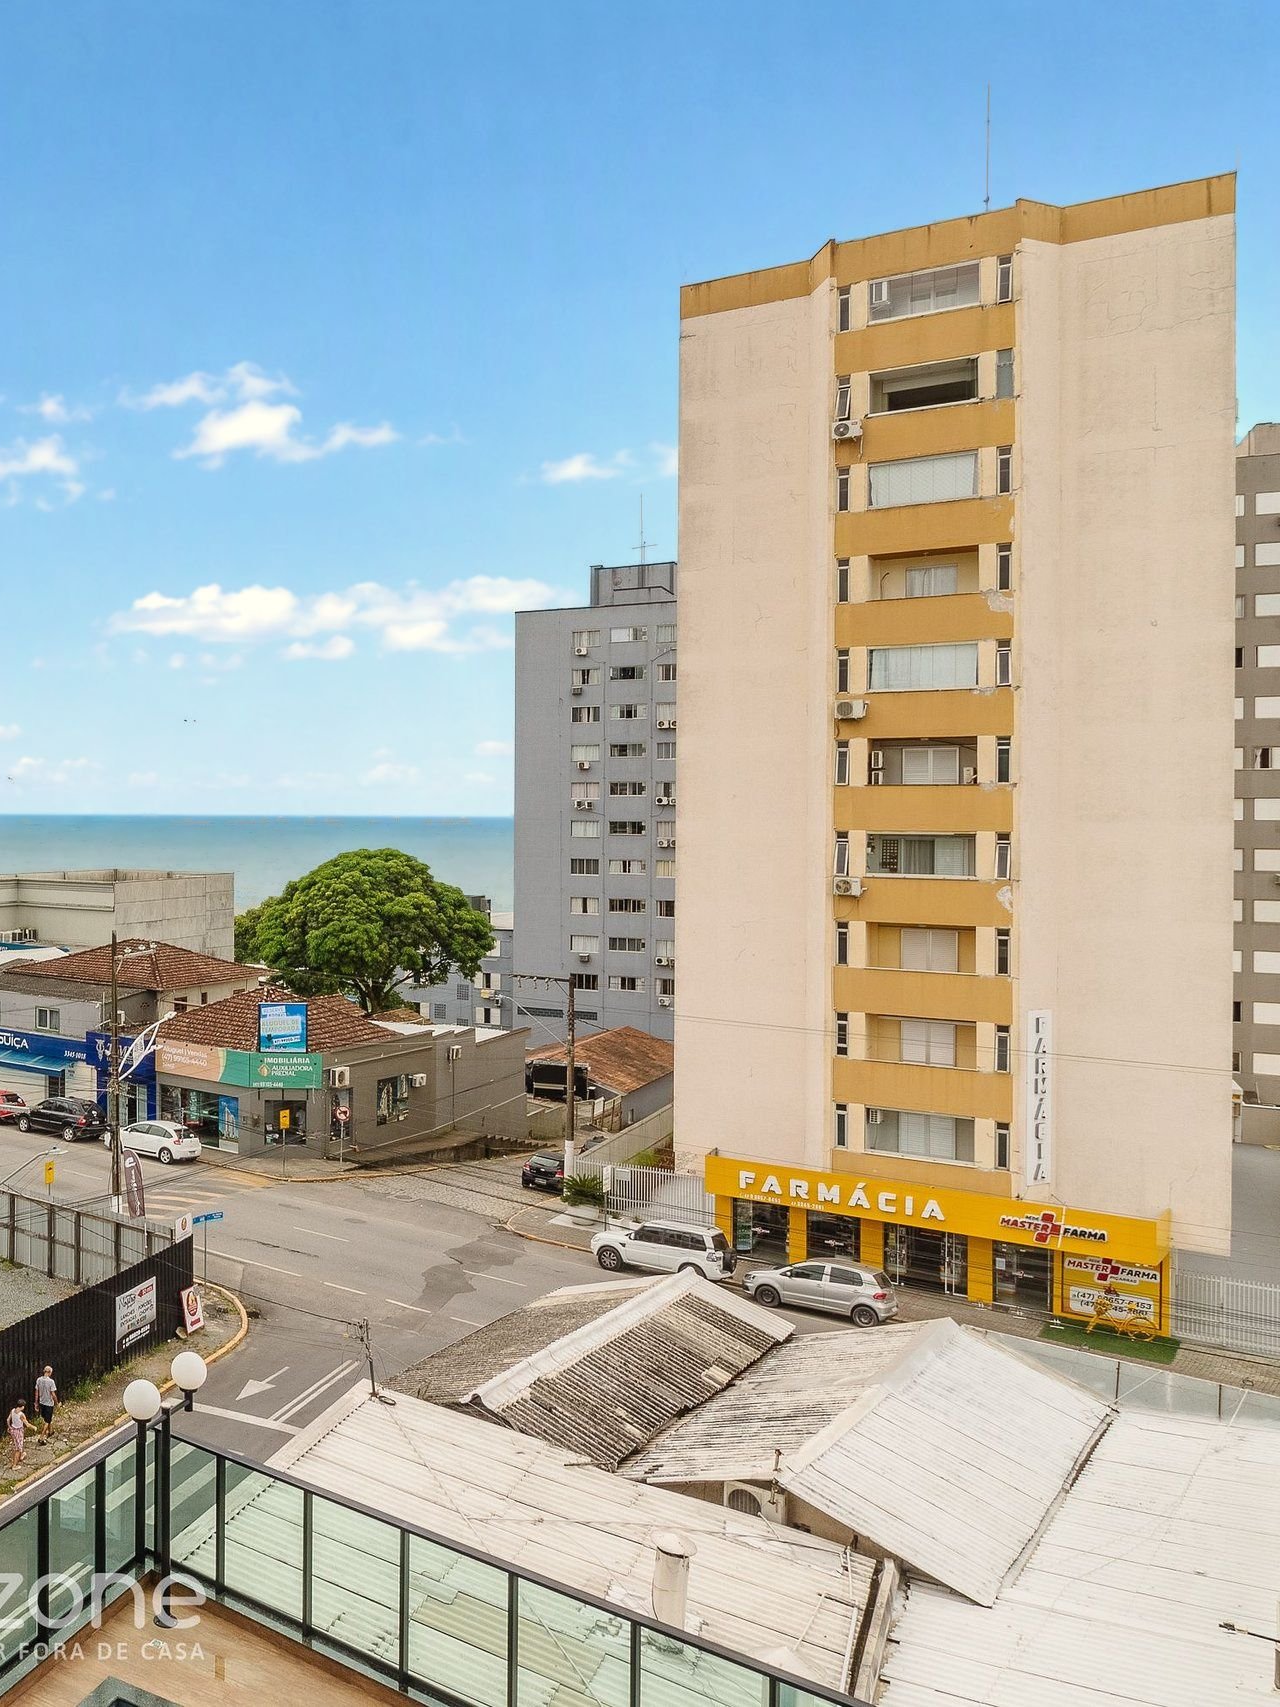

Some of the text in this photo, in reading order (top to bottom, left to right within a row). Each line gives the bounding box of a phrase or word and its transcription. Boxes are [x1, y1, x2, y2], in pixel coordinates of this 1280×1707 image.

[264, 1056, 311, 1064] IMOBILIÁRIA
[739, 1170, 945, 1221] FARMÁCIA
[1000, 1217, 1107, 1242] MASTER FARMA
[1067, 1260, 1159, 1281] MASTER FARMA
[1076, 1291, 1094, 1301] (47)
